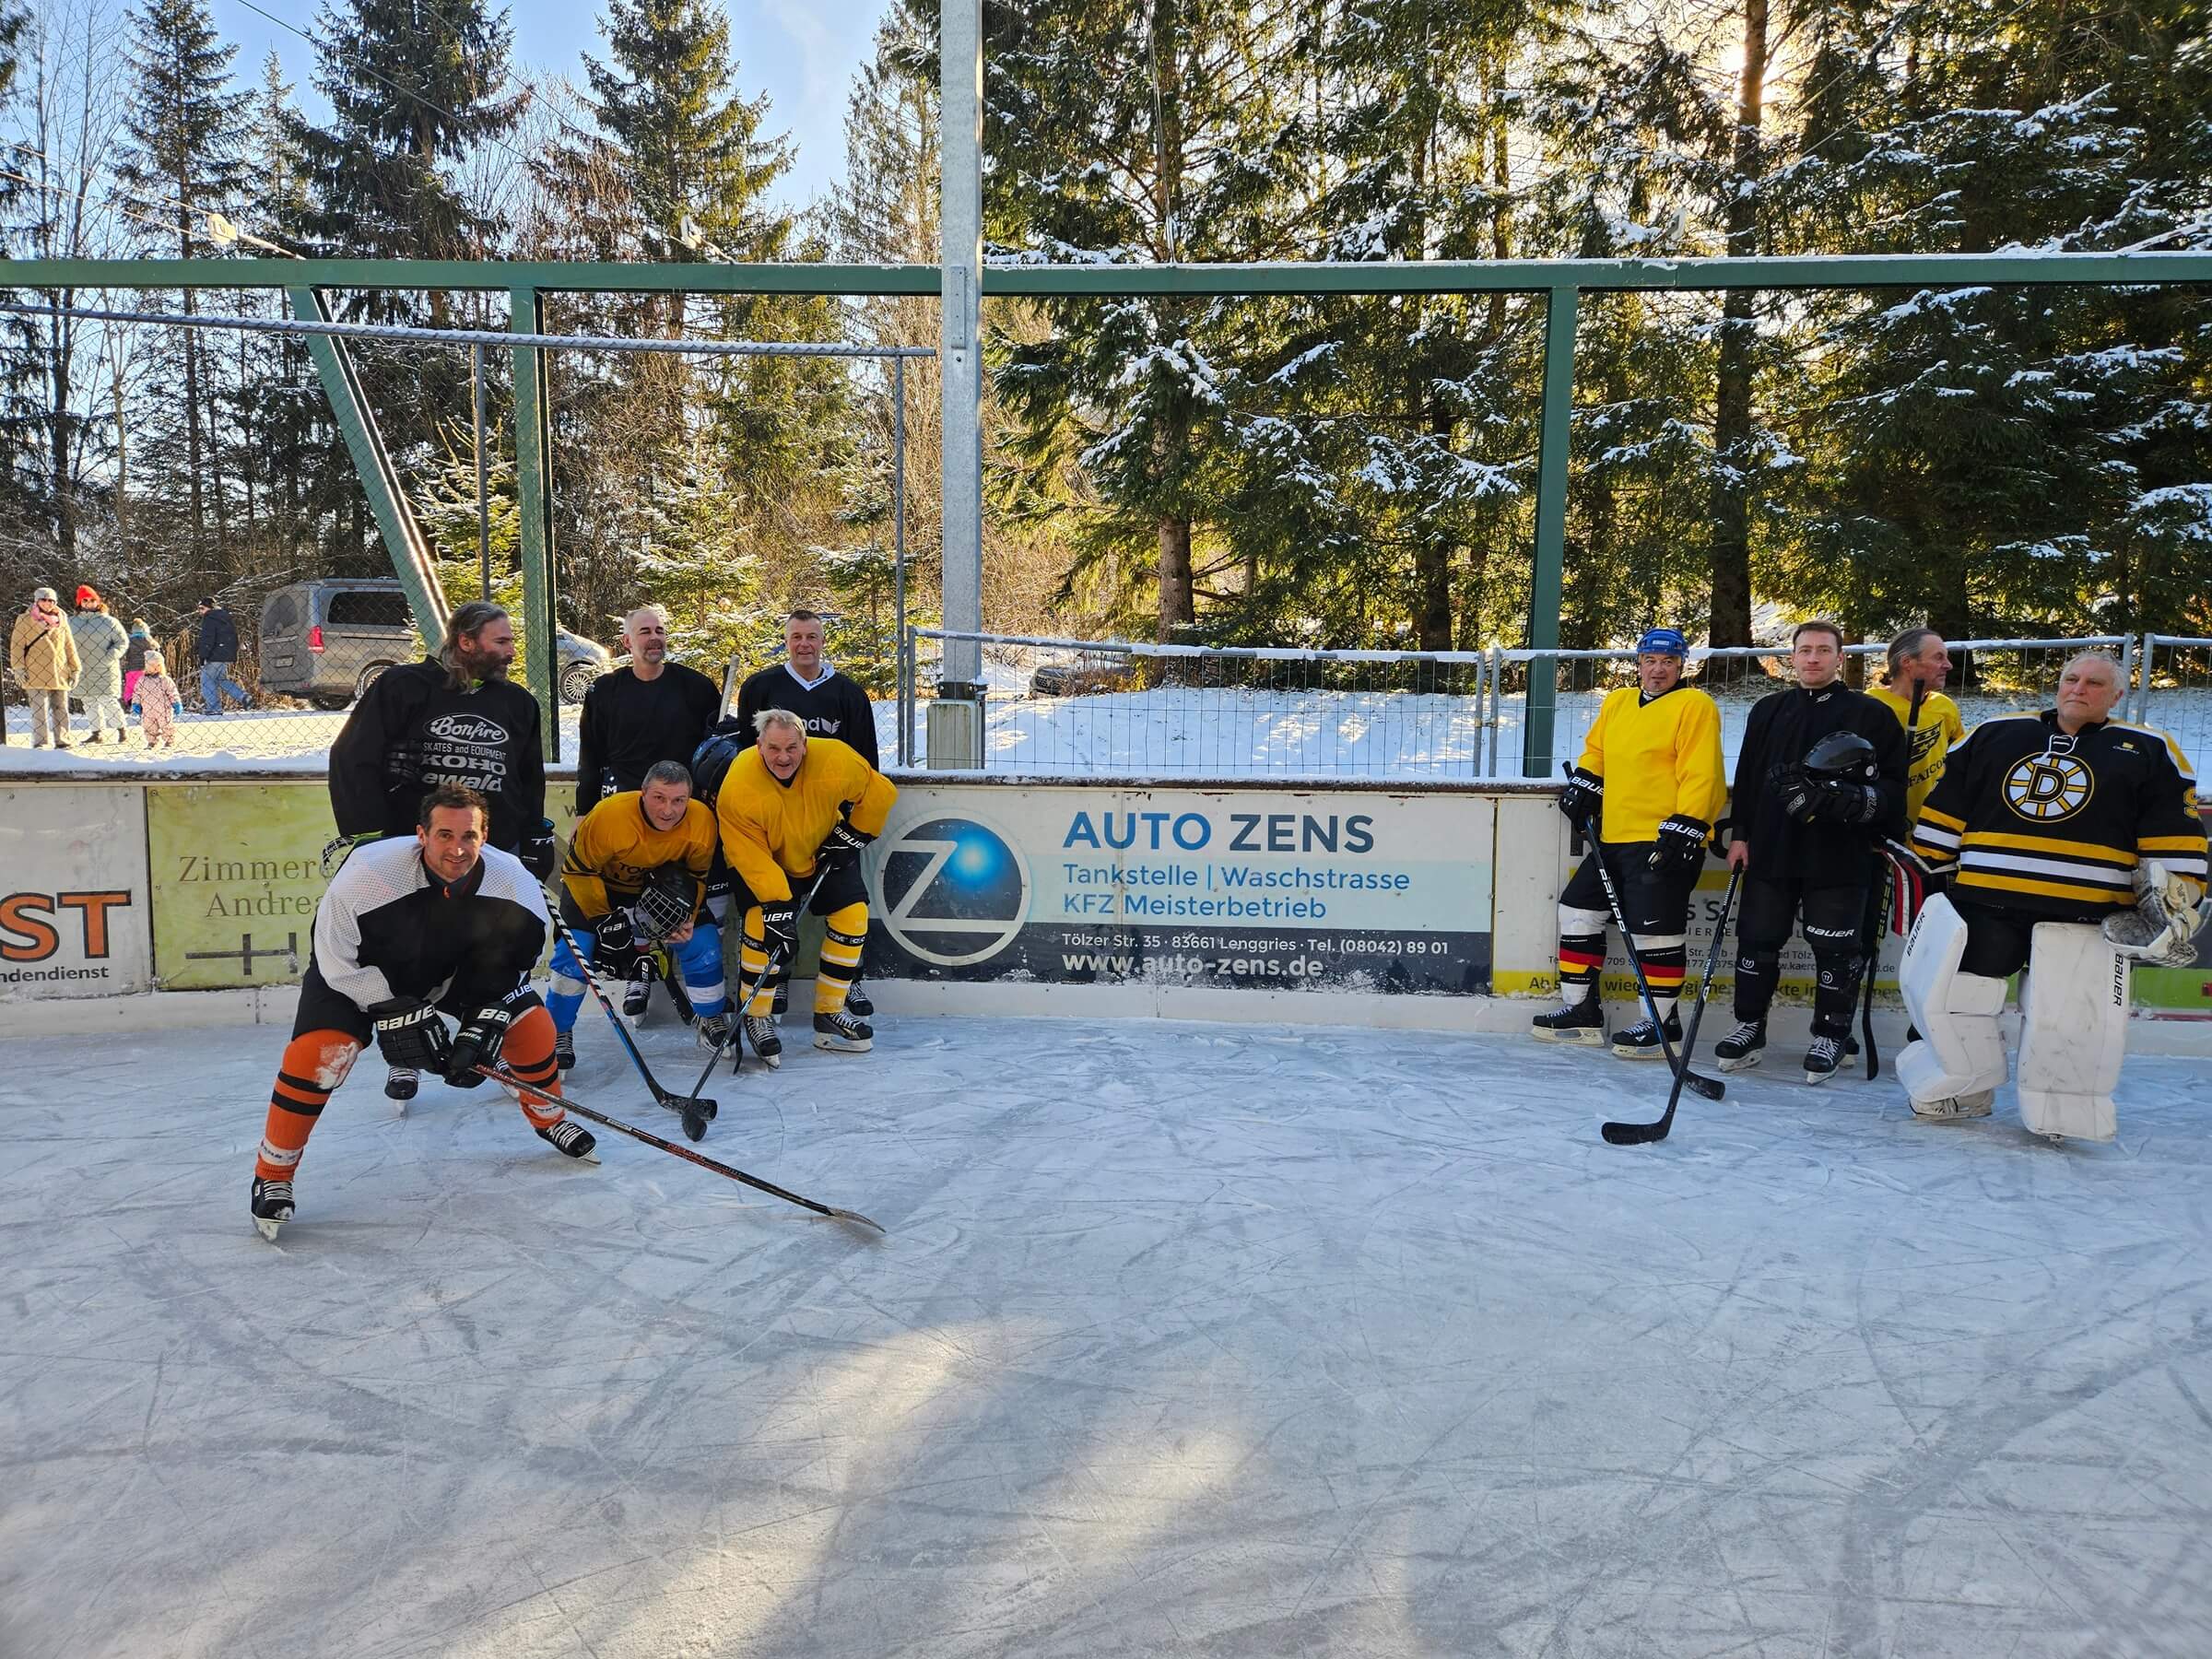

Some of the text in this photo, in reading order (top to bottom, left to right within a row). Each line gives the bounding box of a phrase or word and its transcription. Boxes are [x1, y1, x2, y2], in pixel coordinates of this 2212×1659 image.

[430, 716, 502, 740] Bonfire
[424, 742, 506, 759] SKATES and EQUIPMENT
[421, 755, 506, 775] KOHO
[1570, 776, 1604, 796] BAUE
[833, 826, 865, 849] BAUE
[1063, 811, 1374, 853] AUTO ZENS
[1660, 821, 1705, 841] BAUER
[1063, 864, 1198, 886] Tankstelle
[1221, 866, 1410, 890] Waschstrasse
[1064, 892, 1326, 919] KFZ Meisterbetrieb
[0, 890, 131, 963] ST
[764, 912, 794, 923] UER
[1806, 924, 1854, 937] BAUER
[1907, 911, 1925, 957] BAUER
[1062, 933, 1448, 955] Tölzer Str. 35 83661 Lenggries Tel. (08042) 89 01
[1062, 952, 1324, 976] www.auto-zens.de
[2112, 953, 2124, 1006] BAUER
[502, 984, 531, 1005] AUE
[376, 1005, 436, 1031] BAUE
